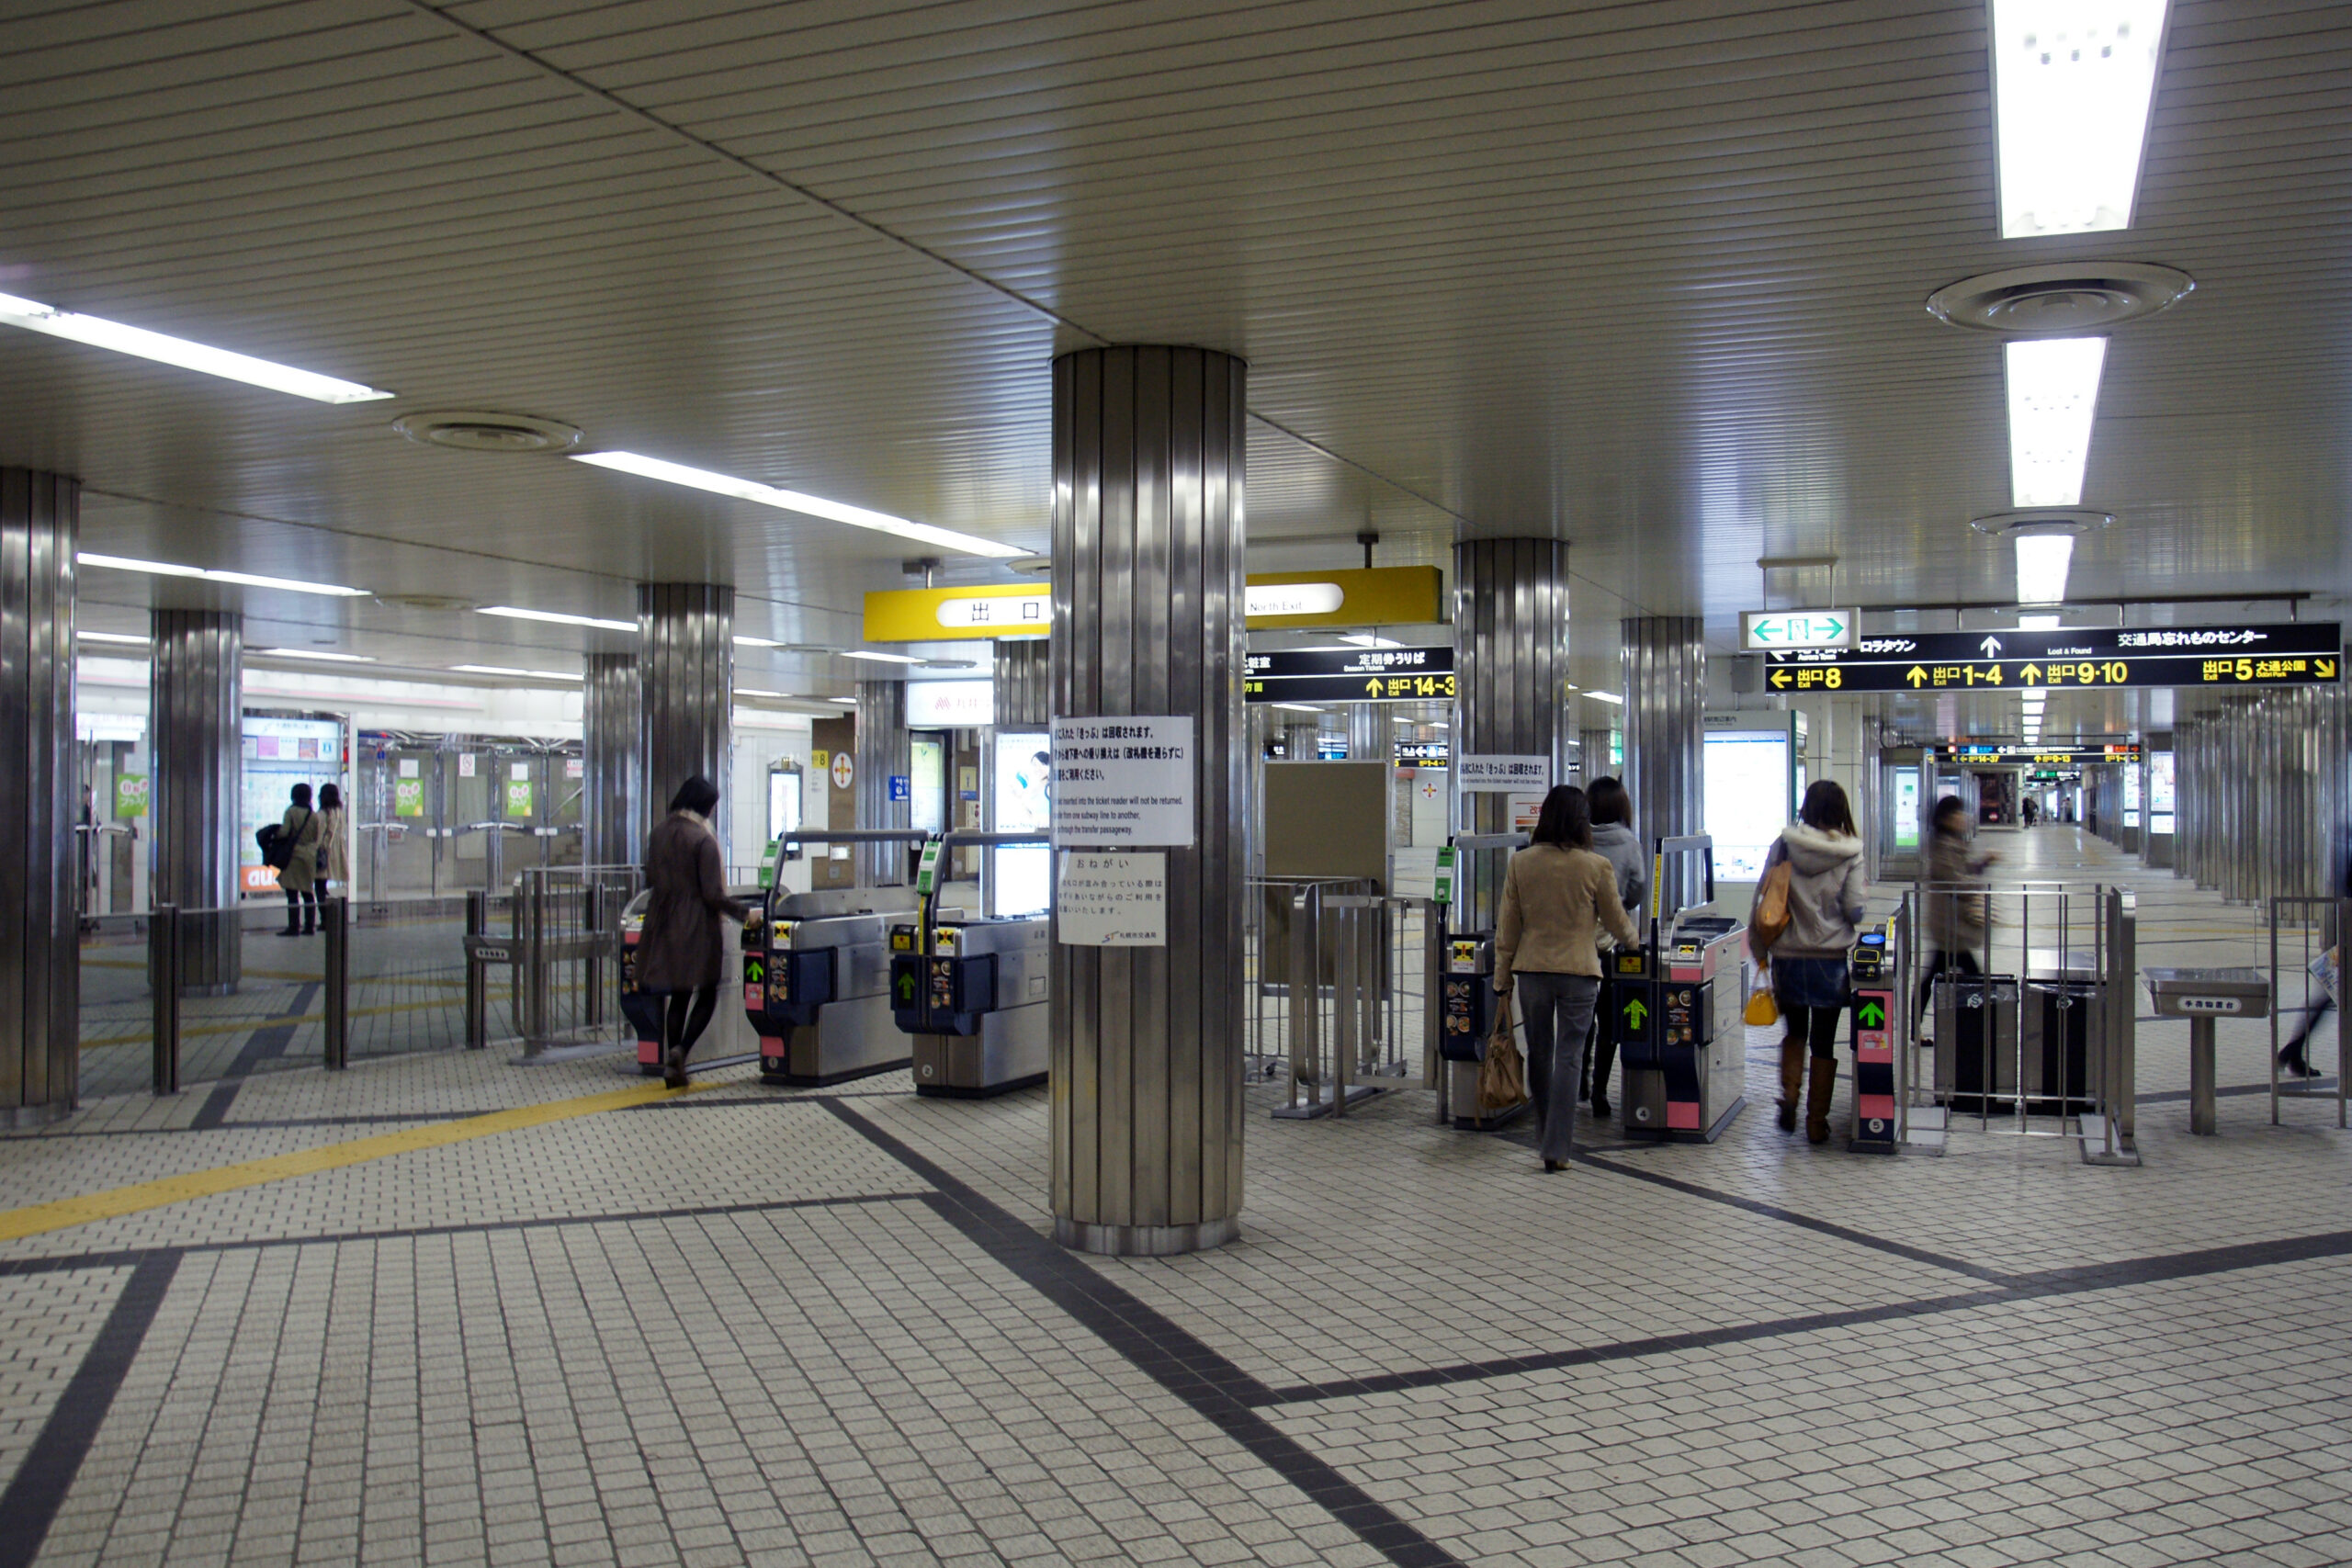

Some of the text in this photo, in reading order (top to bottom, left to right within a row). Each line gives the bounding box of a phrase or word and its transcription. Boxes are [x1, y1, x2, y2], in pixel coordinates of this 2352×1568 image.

[1250, 601, 1301, 612] North Exit
[2118, 629, 2267, 647] 交通局忘れものセンター
[2070, 647, 2092, 655] Found
[1359, 651, 1426, 665] 定期券うりば
[2256, 660, 2306, 672] 大通公園
[1095, 795, 1110, 806] ticket
[1111, 795, 1128, 806] reader
[1129, 795, 1139, 806] will
[1140, 796, 1149, 805] not
[1150, 795, 1159, 805] be
[1159, 795, 1182, 806] returned.
[1081, 810, 1099, 821] subway
[1100, 811, 1110, 819] line
[1117, 811, 1140, 820] another,
[1081, 824, 1099, 833] transfer
[1100, 826, 1132, 836] passageway.
[1077, 858, 1129, 869] おねがい
